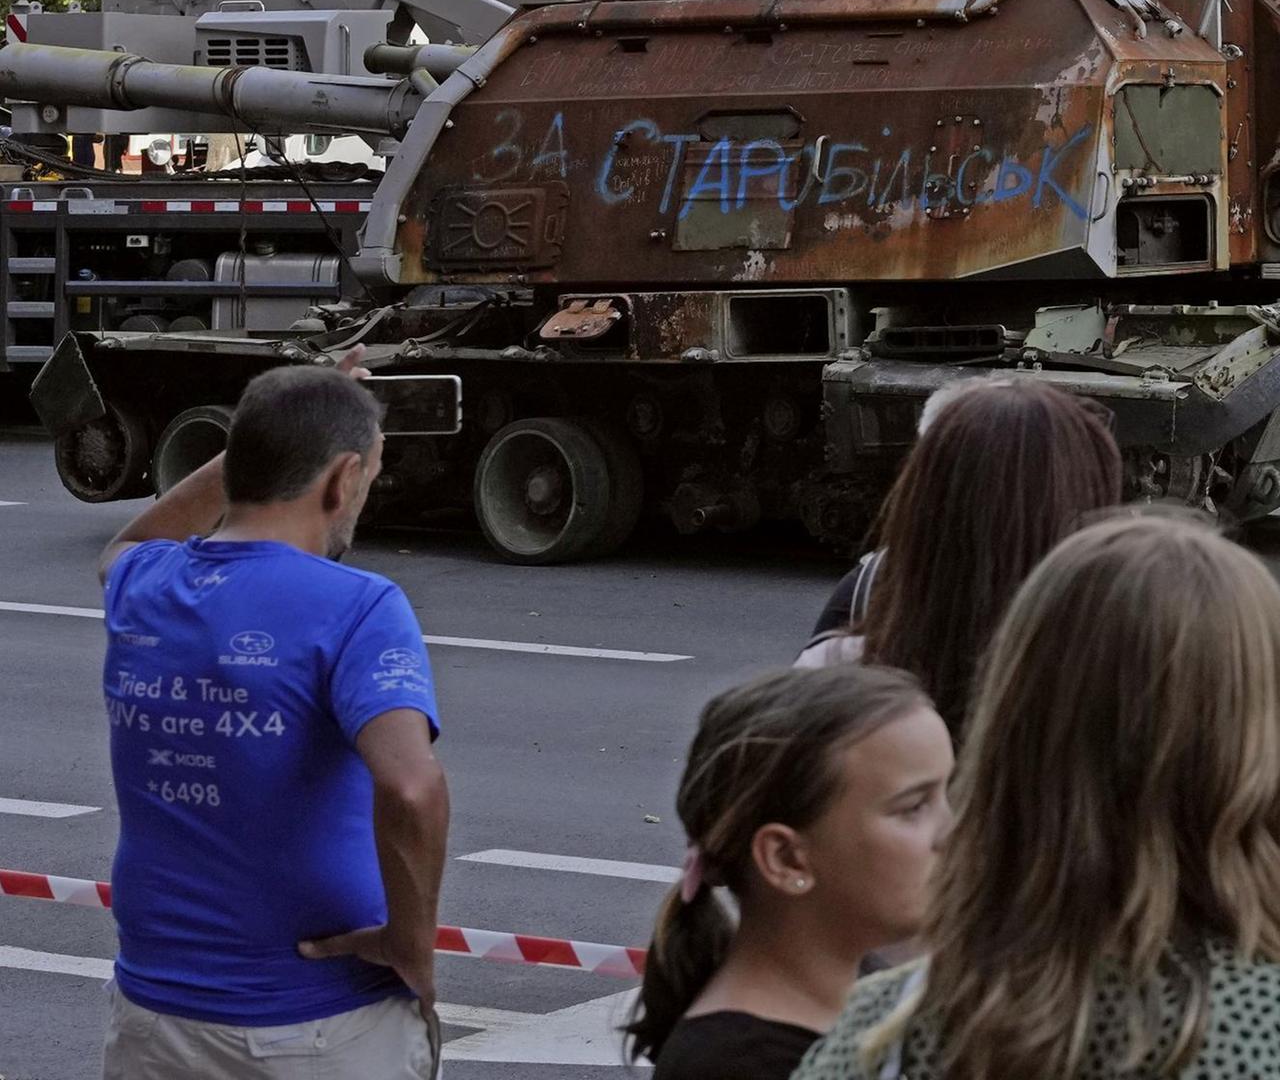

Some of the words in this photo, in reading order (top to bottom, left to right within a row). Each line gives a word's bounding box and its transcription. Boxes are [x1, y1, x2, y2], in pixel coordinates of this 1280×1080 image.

[474, 108, 569, 182] ЗА
[218, 655, 278, 666] SUBARU
[118, 670, 162, 699] Tried
[170, 675, 188, 700] &
[196, 678, 249, 703] True
[161, 716, 204, 736] are
[215, 710, 286, 738] 4X4
[175, 753, 217, 769] MODE
